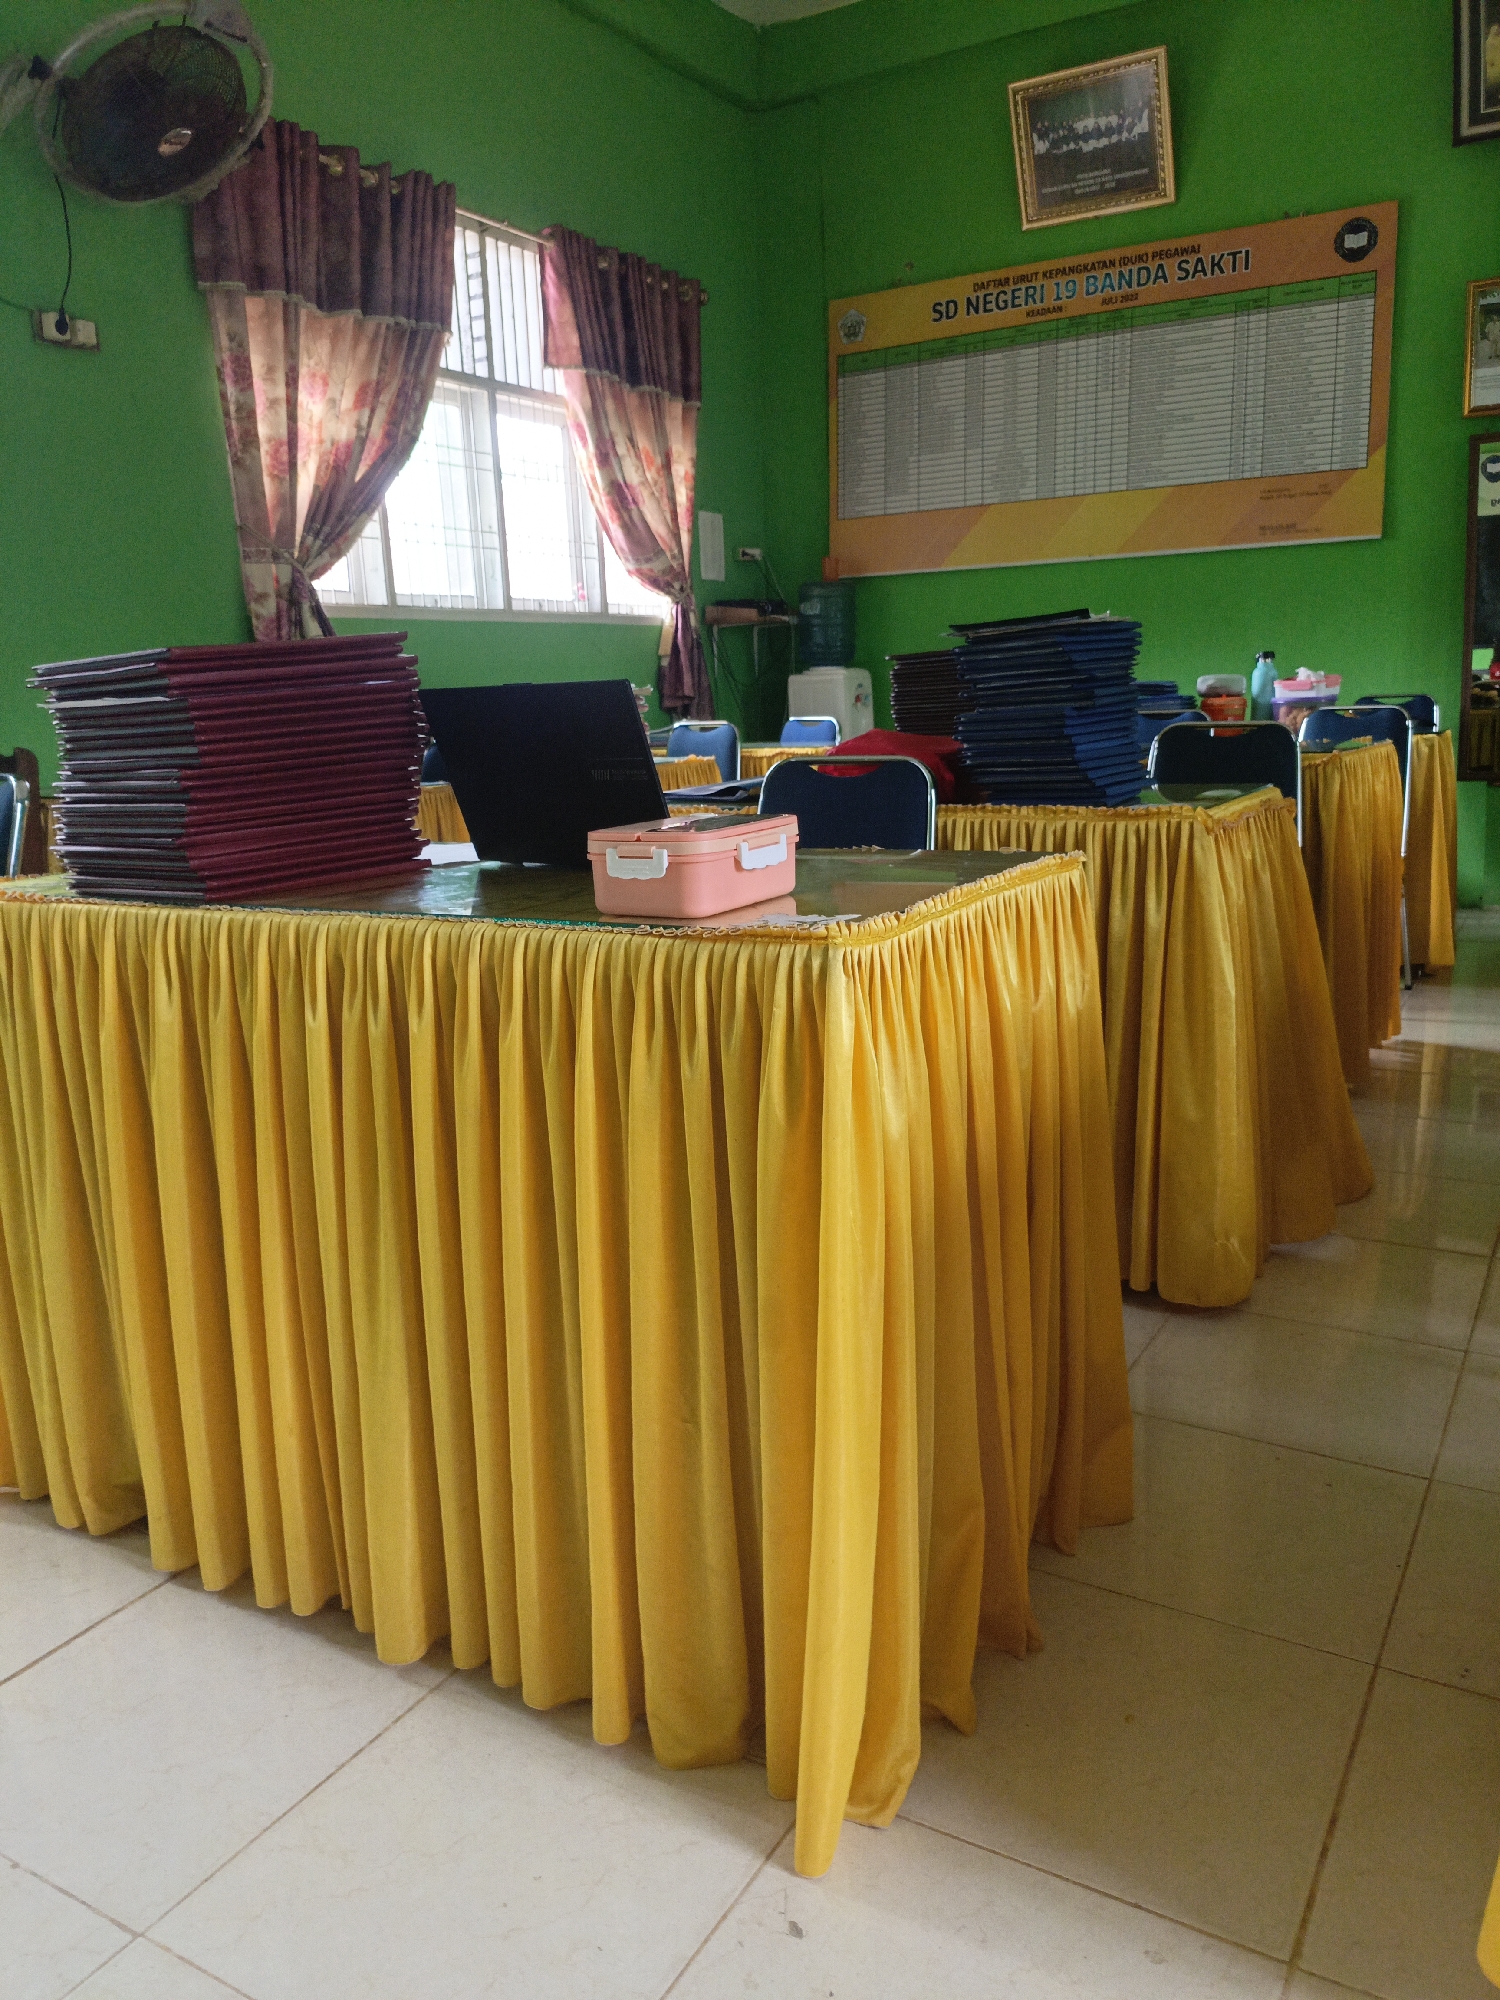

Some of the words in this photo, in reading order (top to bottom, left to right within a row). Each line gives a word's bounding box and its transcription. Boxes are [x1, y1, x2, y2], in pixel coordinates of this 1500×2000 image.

[931, 299, 959, 323] SD
[965, 283, 1045, 317] NEGERI
[1052, 279, 1077, 302] 19
[1084, 262, 1169, 297] BANDA
[1176, 248, 1251, 282] SAKTI
[973, 277, 1010, 293] DAFTAR
[1012, 272, 1040, 285] URUT
[1041, 258, 1116, 280] KEPANGKATAN
[1151, 243, 1201, 260] PEGAWAI
[1025, 305, 1063, 318] KEADAAN
